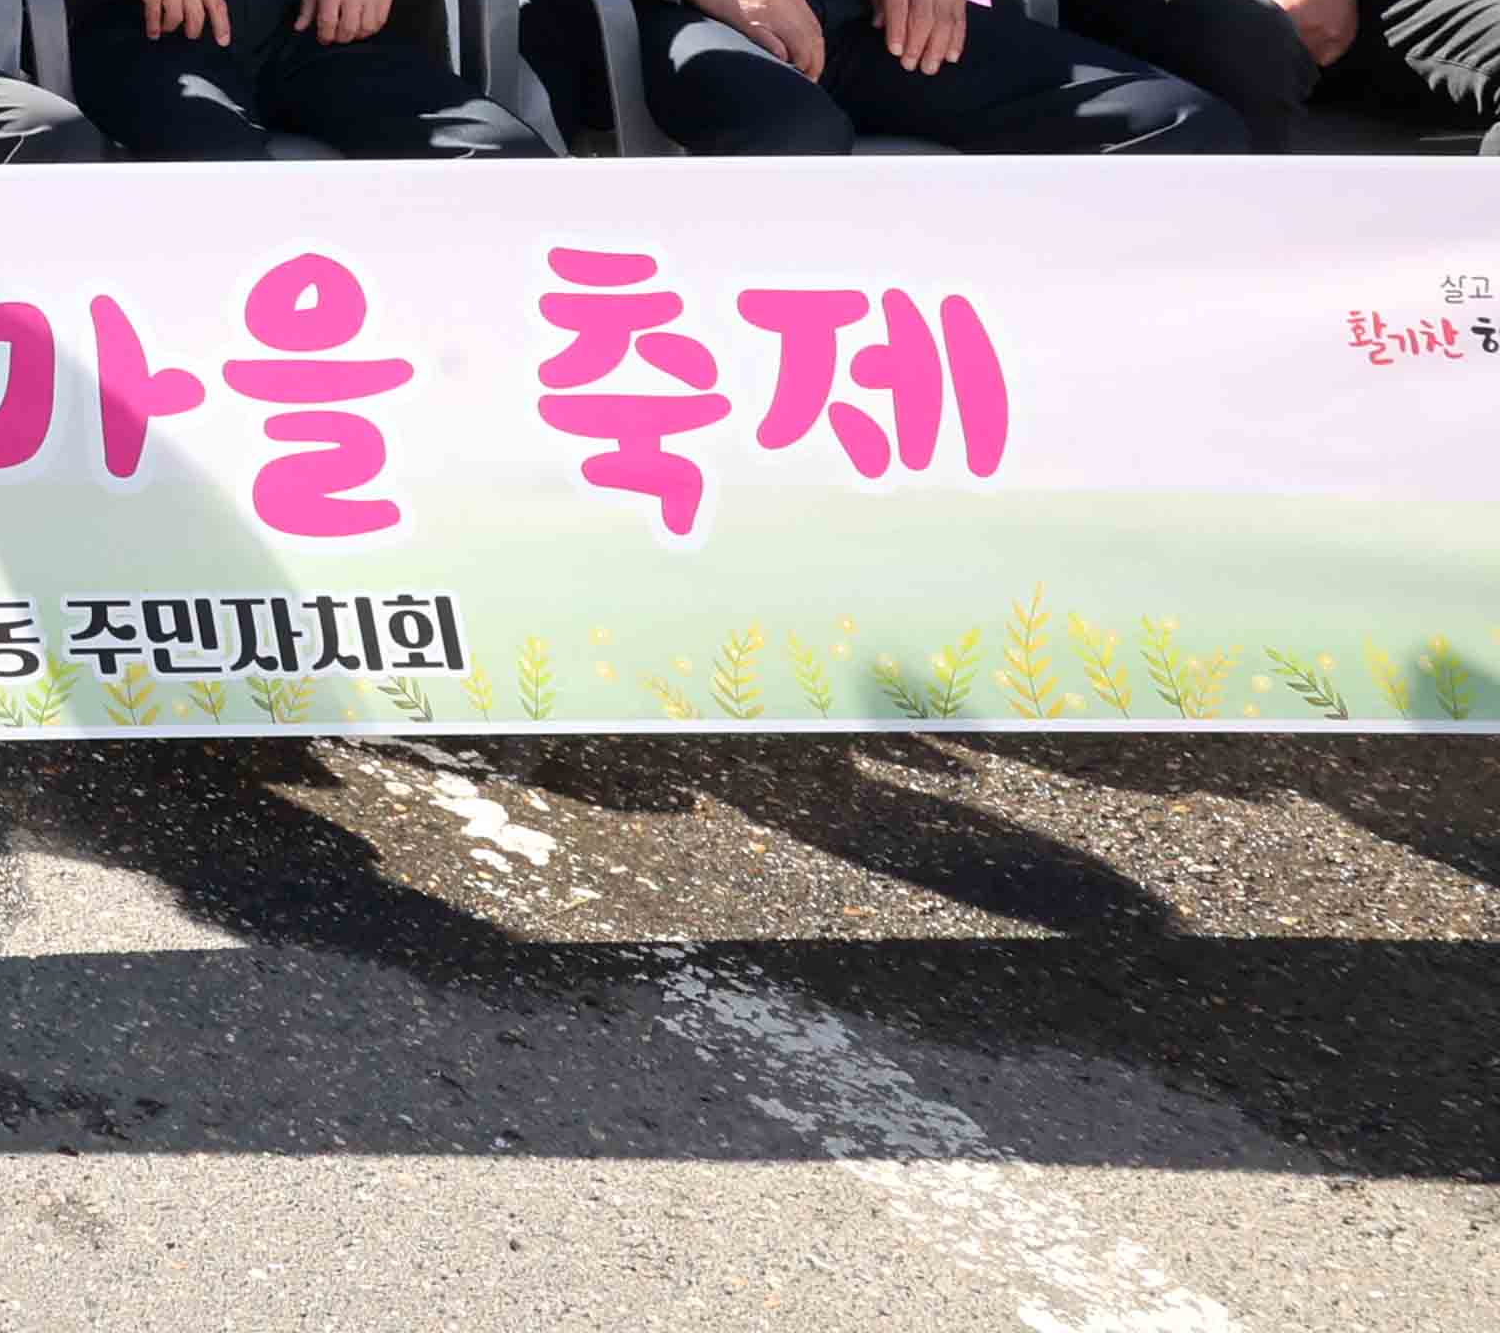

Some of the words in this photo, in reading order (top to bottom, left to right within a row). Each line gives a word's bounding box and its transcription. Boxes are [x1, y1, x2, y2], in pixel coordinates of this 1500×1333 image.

[1440, 275, 1493, 304] 살고
[1347, 310, 1464, 365] 활기찬
[538, 247, 1009, 537] 축제
[68, 593, 468, 677] 주민자치회
